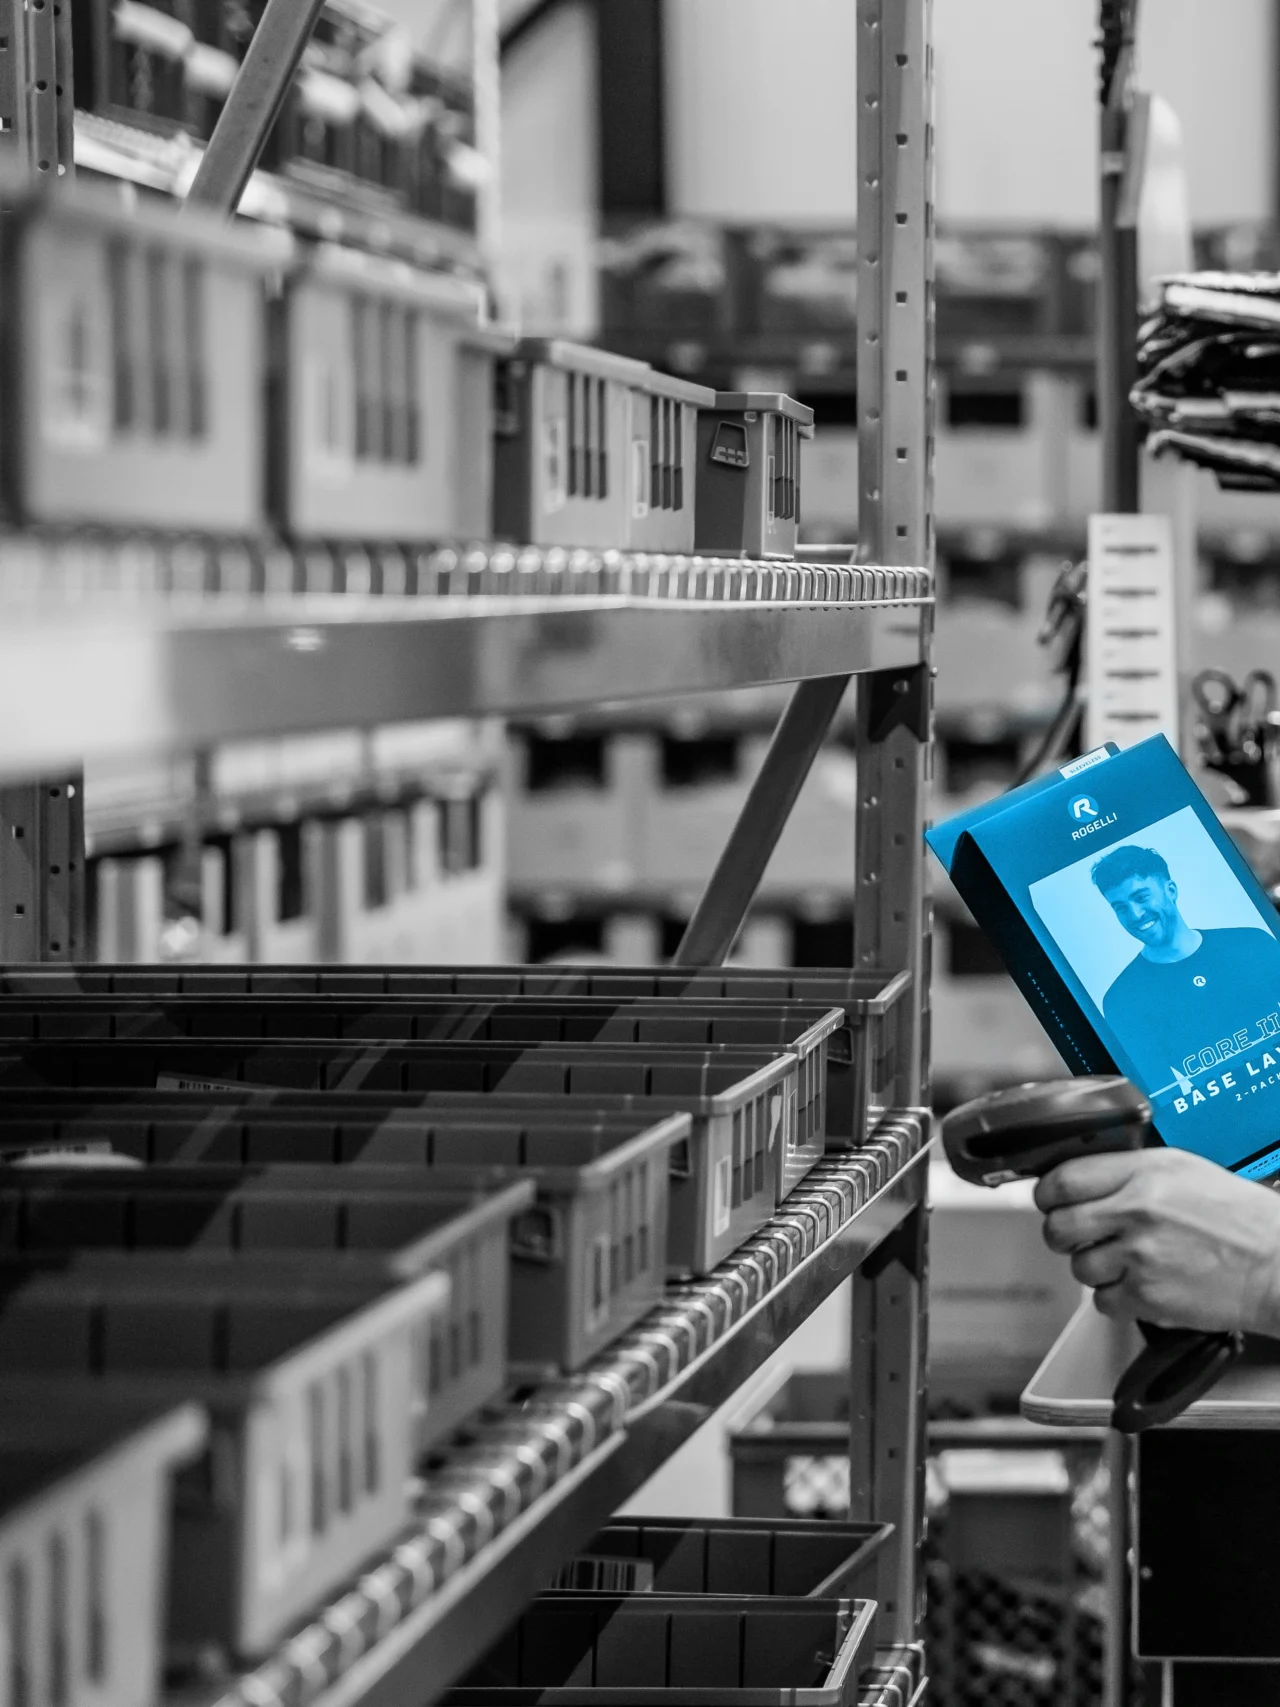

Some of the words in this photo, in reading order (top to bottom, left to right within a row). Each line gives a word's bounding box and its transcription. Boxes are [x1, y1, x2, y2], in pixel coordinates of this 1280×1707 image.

[1069, 755, 1102, 774] SLEEVELESS
[1073, 798, 1098, 819] R
[1071, 812, 1118, 841] ROGELLI
[1182, 1028, 1254, 1077] CORE
[1173, 1071, 1237, 1114] BASE
